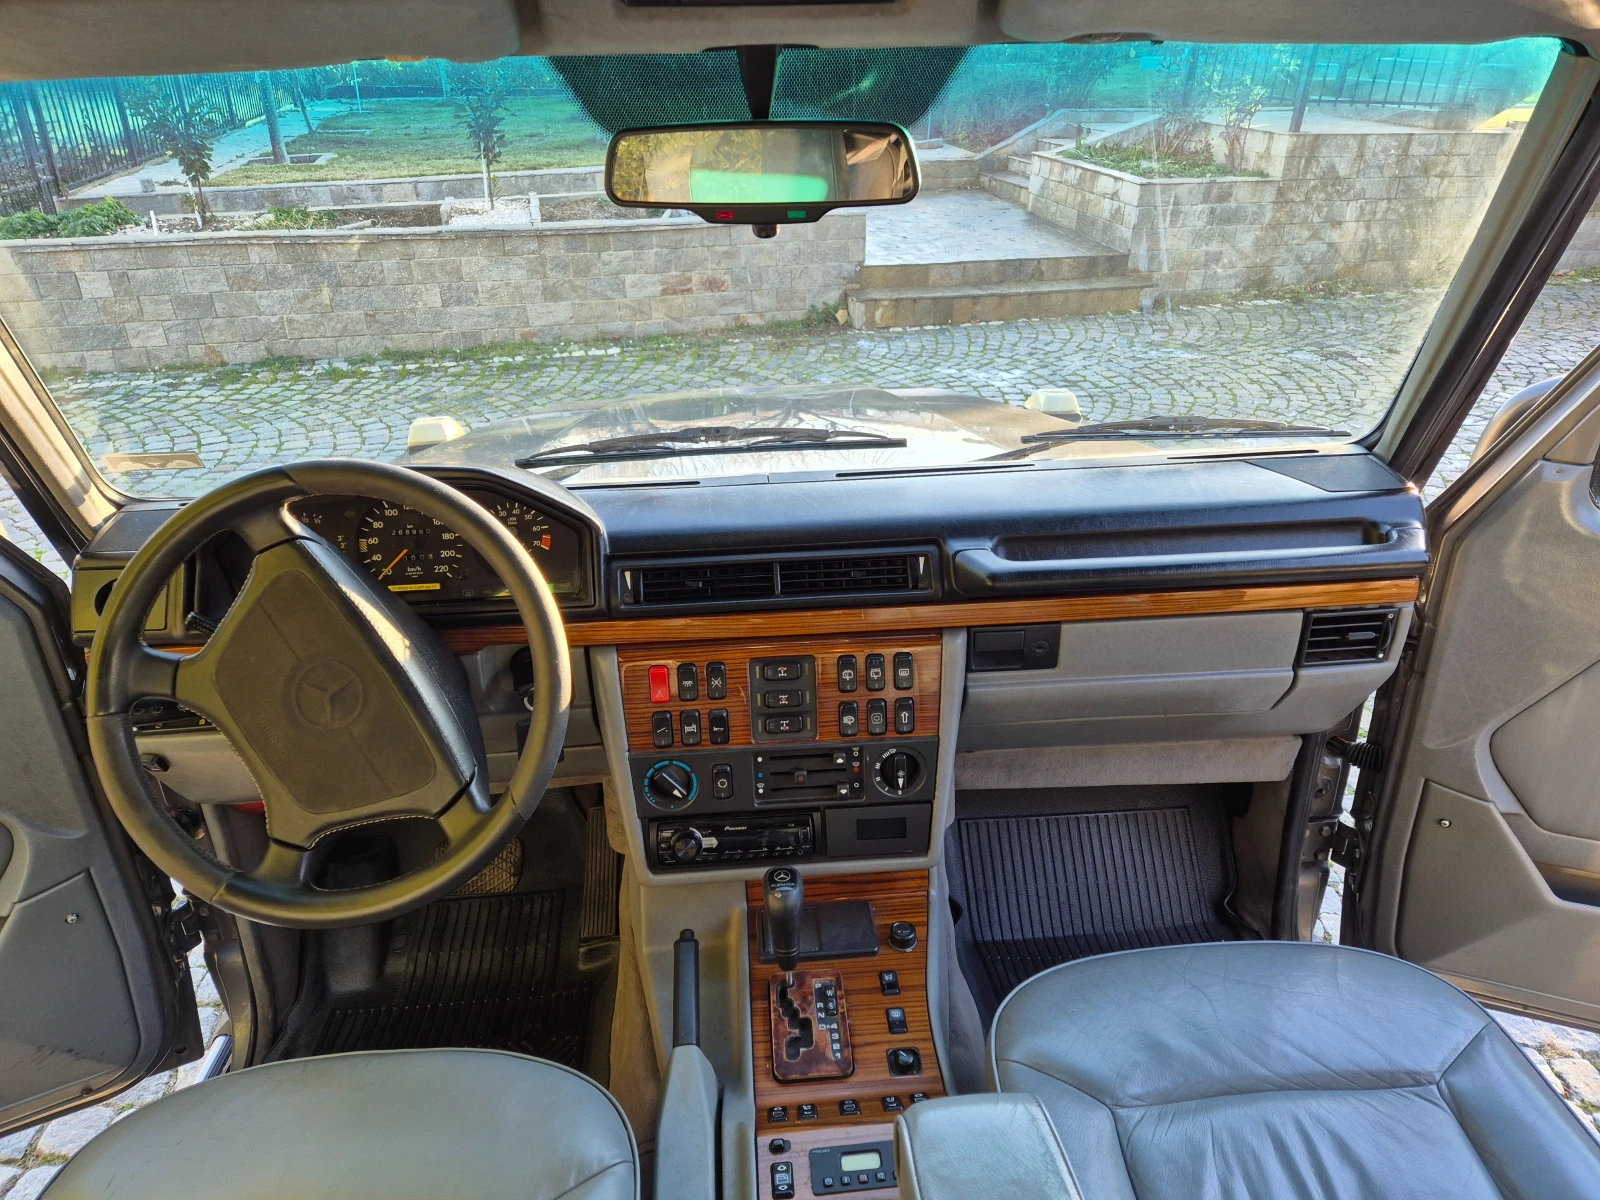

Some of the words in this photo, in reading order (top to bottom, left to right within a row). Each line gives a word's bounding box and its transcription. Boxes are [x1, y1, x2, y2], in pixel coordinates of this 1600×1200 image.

[384, 509, 398, 517] 100
[373, 521, 384, 529] 80
[432, 518, 444, 526] 16
[441, 532, 455, 540] 180
[367, 537, 379, 545] 60
[371, 553, 382, 561] 40
[440, 550, 456, 558] 200
[433, 565, 449, 573] 220
[826, 989, 834, 997] W
[828, 1002, 834, 1010] S
